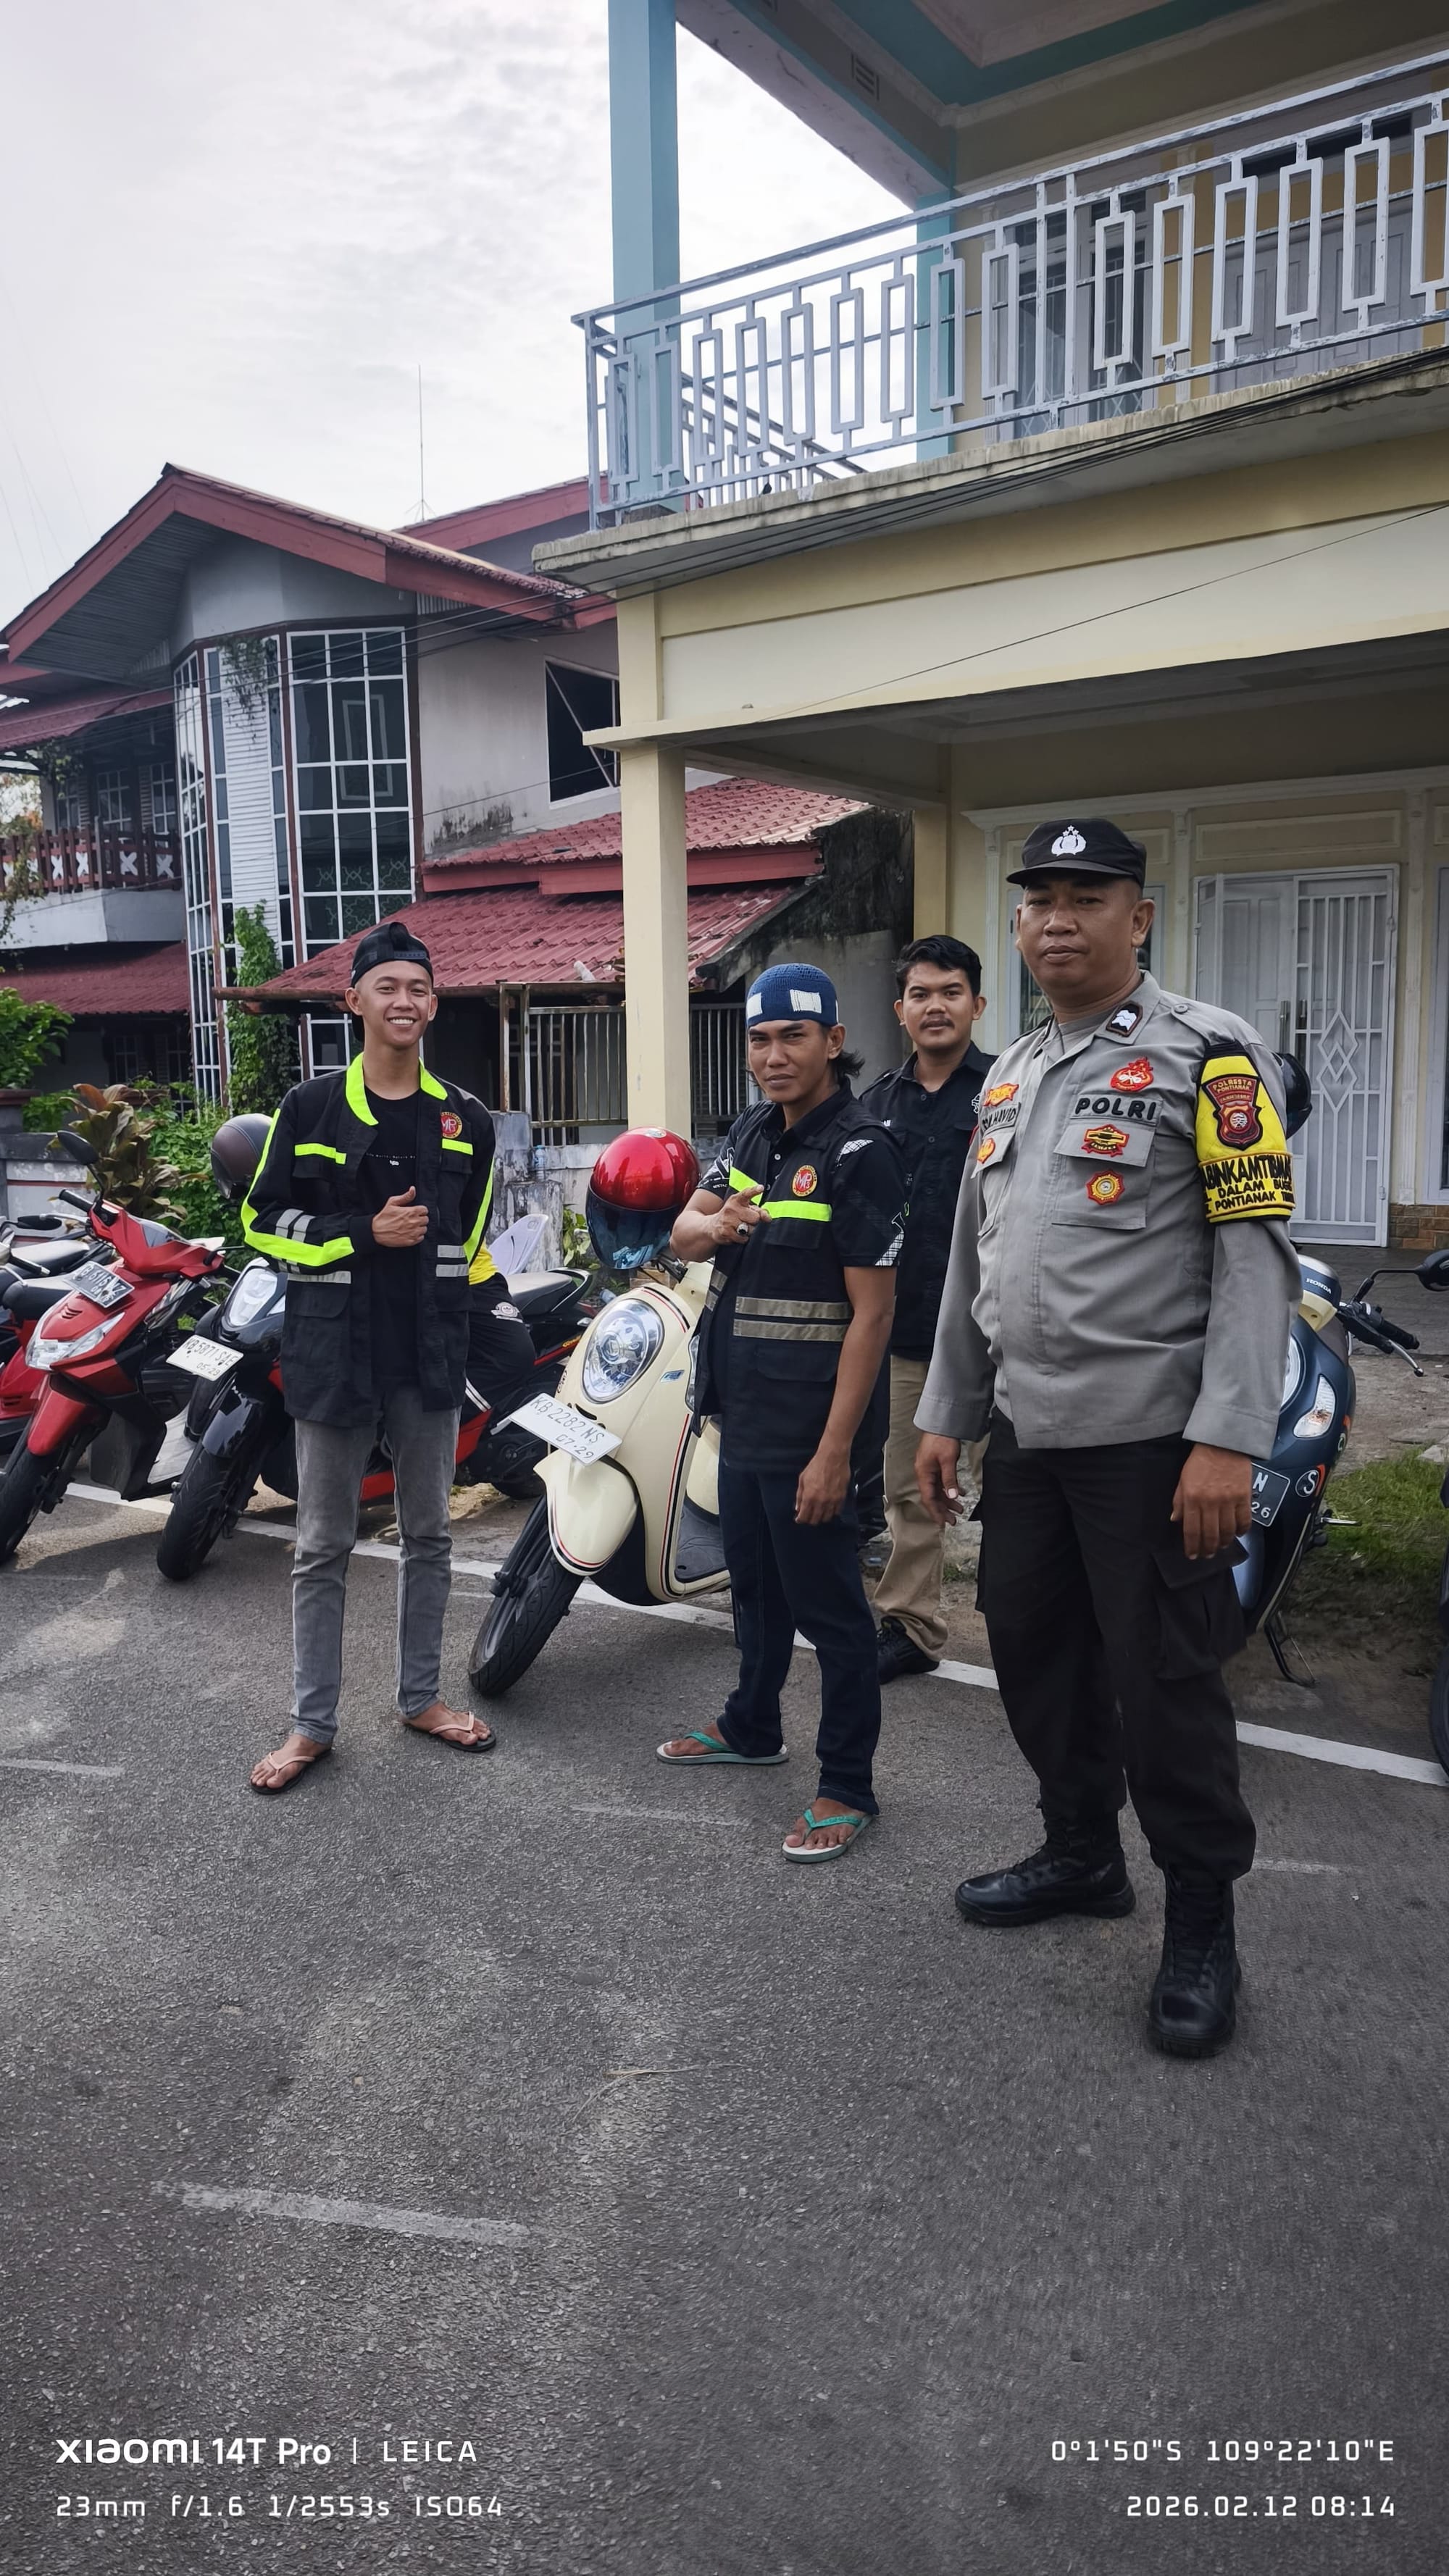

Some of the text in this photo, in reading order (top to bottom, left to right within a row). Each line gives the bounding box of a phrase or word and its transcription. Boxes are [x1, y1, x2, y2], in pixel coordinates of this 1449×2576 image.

[1075, 1097, 1156, 1120] POLRI
[1217, 1179, 1265, 1199] DALAM
[1214, 1191, 1277, 1211] PONTIANAK
[1306, 1278, 1332, 1295] HONDA
[183, 1338, 200, 1350] KB
[530, 1396, 605, 1444] KB 2282 NS
